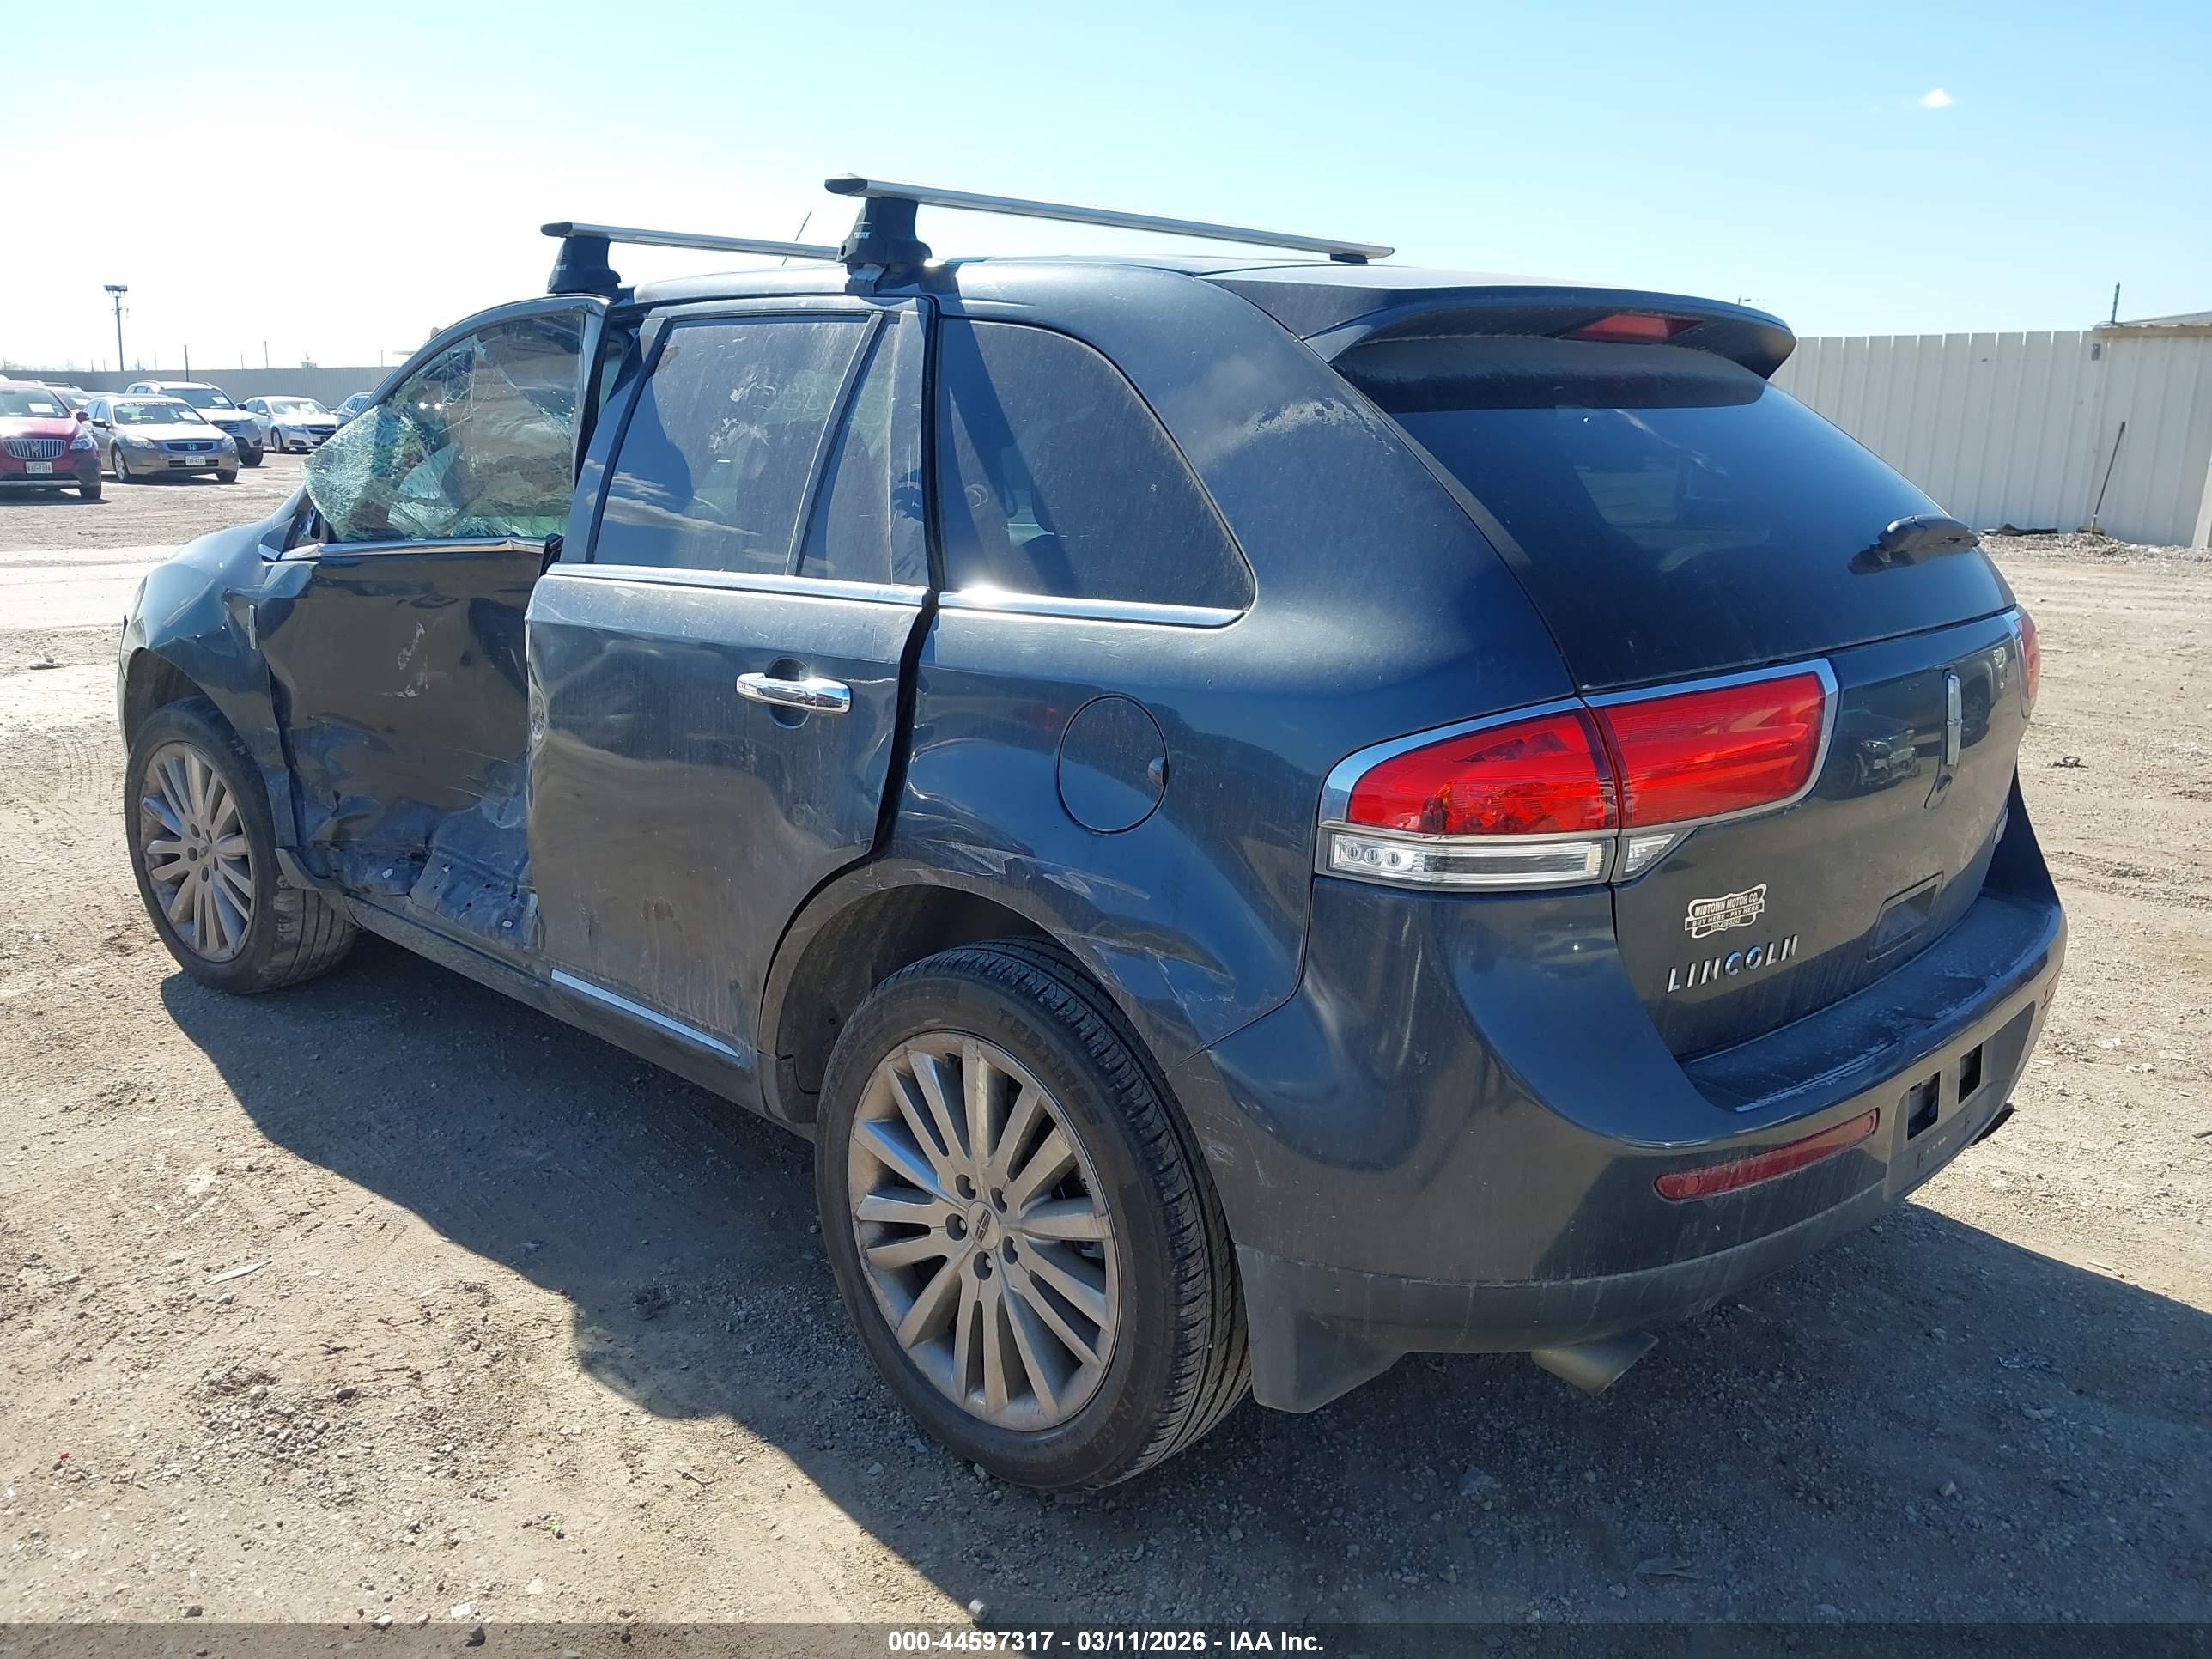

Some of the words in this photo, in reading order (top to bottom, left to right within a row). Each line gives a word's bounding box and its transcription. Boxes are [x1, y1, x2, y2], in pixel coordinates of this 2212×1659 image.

[1692, 918, 1707, 927] BUY
[1707, 913, 1725, 923] HERE
[1729, 908, 1742, 918] PAY
[1742, 904, 1759, 915] HERE
[1694, 901, 1726, 917] MIDTOWN
[1726, 895, 1748, 909] MOTOR
[1748, 892, 1759, 903] CO.
[1668, 934, 1798, 993] LINCOLN
